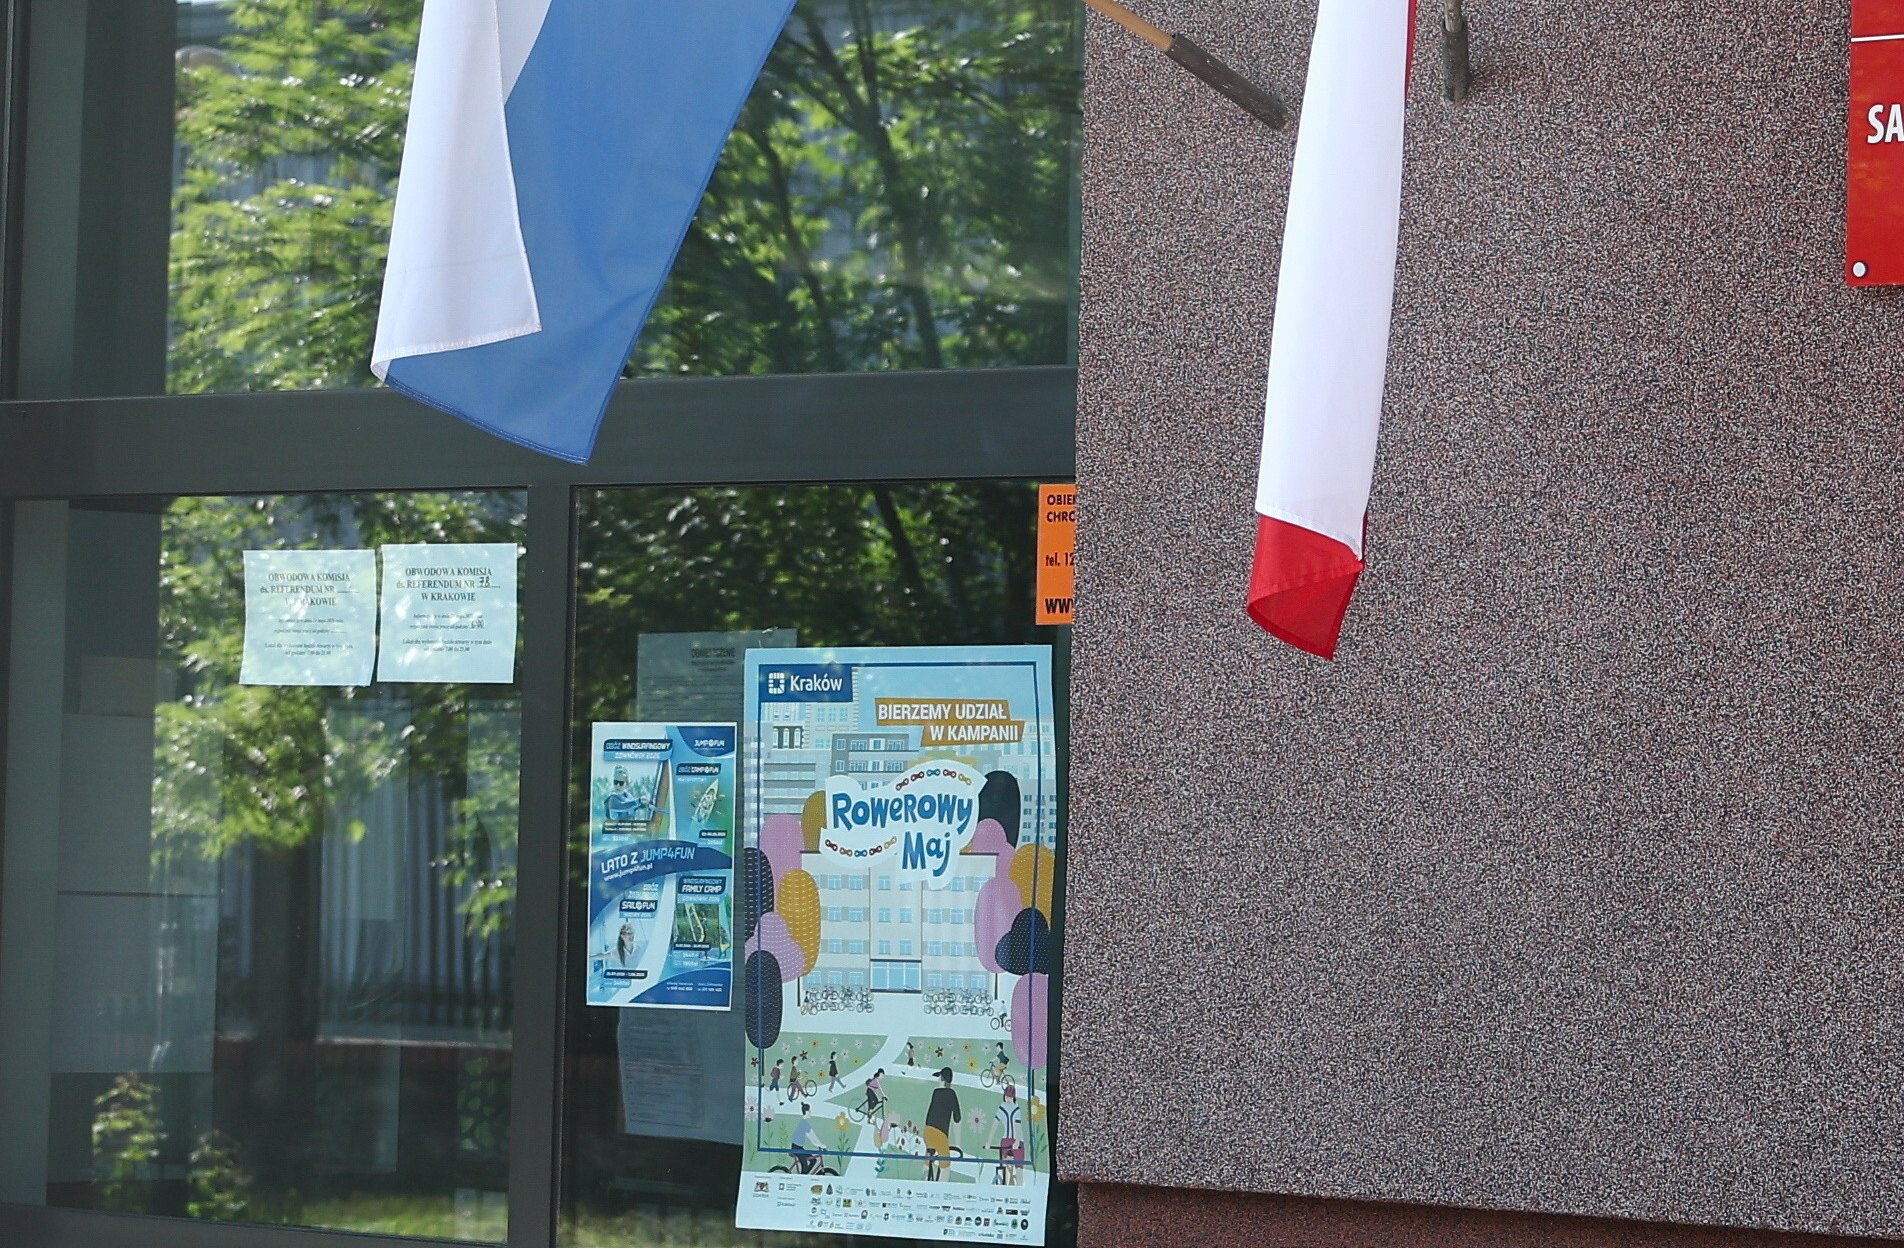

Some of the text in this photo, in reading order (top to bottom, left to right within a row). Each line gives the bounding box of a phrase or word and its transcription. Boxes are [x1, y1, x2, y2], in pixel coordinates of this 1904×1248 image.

[1045, 552, 1060, 566] tel.
[317, 573, 350, 582] KOMISJA
[405, 567, 493, 576] OBWODOWA KOMISJA
[407, 580, 462, 589] REFERENDUM
[431, 592, 476, 601] KRAKOWIE
[790, 674, 843, 692] Kraków
[878, 703, 1007, 720] BIERZEMY UDZIAŁ
[930, 724, 1018, 741] W KAMPANII
[601, 847, 696, 873] LATO Z JUMP4FUN
[902, 831, 951, 877] Maj
